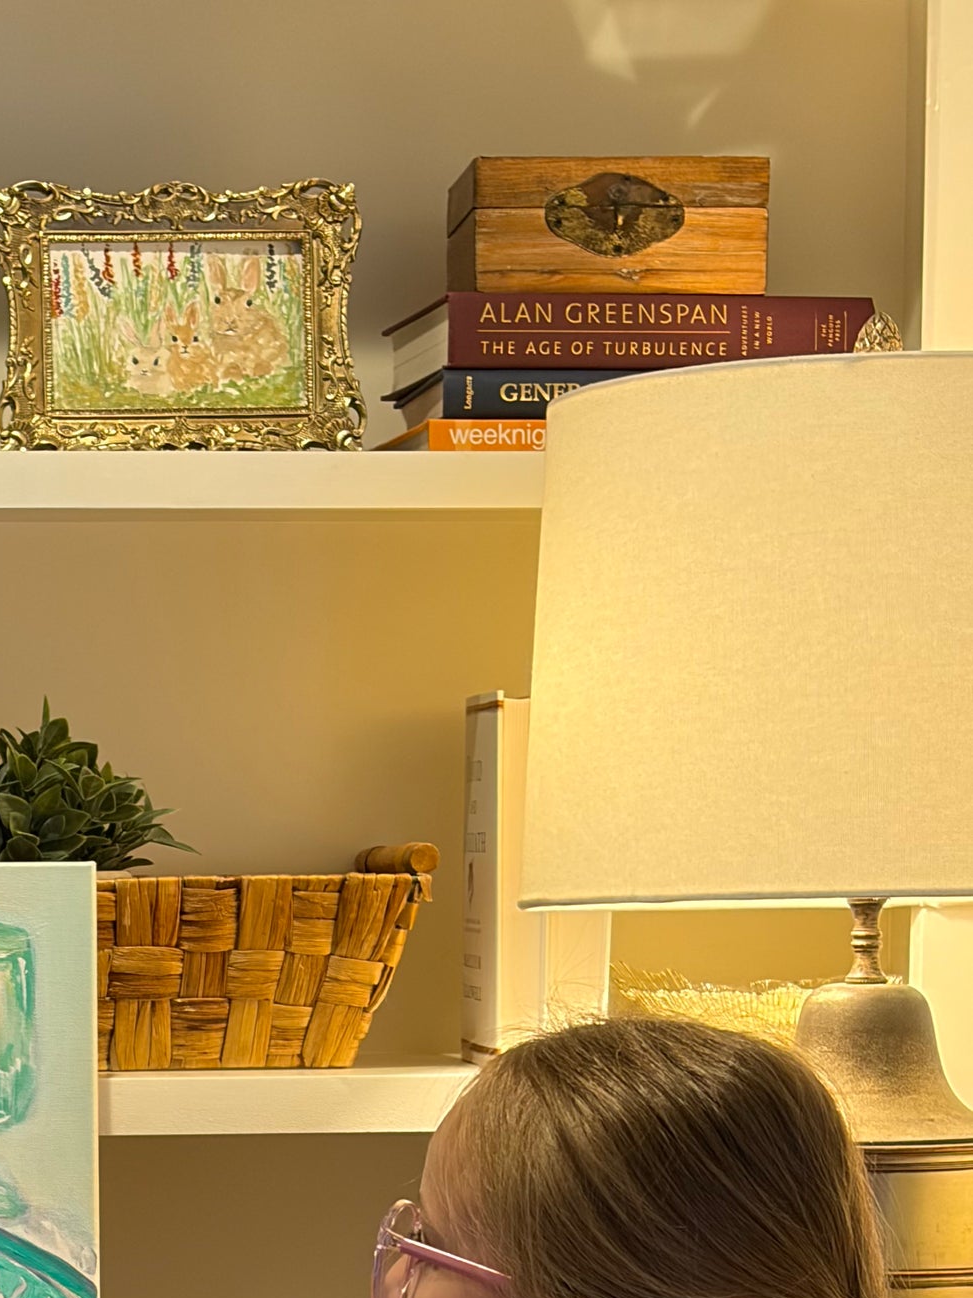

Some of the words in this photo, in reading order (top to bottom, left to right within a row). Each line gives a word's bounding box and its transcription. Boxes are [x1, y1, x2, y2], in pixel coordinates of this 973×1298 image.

[479, 302, 552, 325] ALAN
[564, 302, 728, 325] GREENSPAN
[480, 340, 516, 355] THE
[525, 341, 562, 355] AGE
[571, 341, 594, 356] OF
[603, 341, 728, 357] TURBULENCE
[449, 423, 546, 450] weeknig
